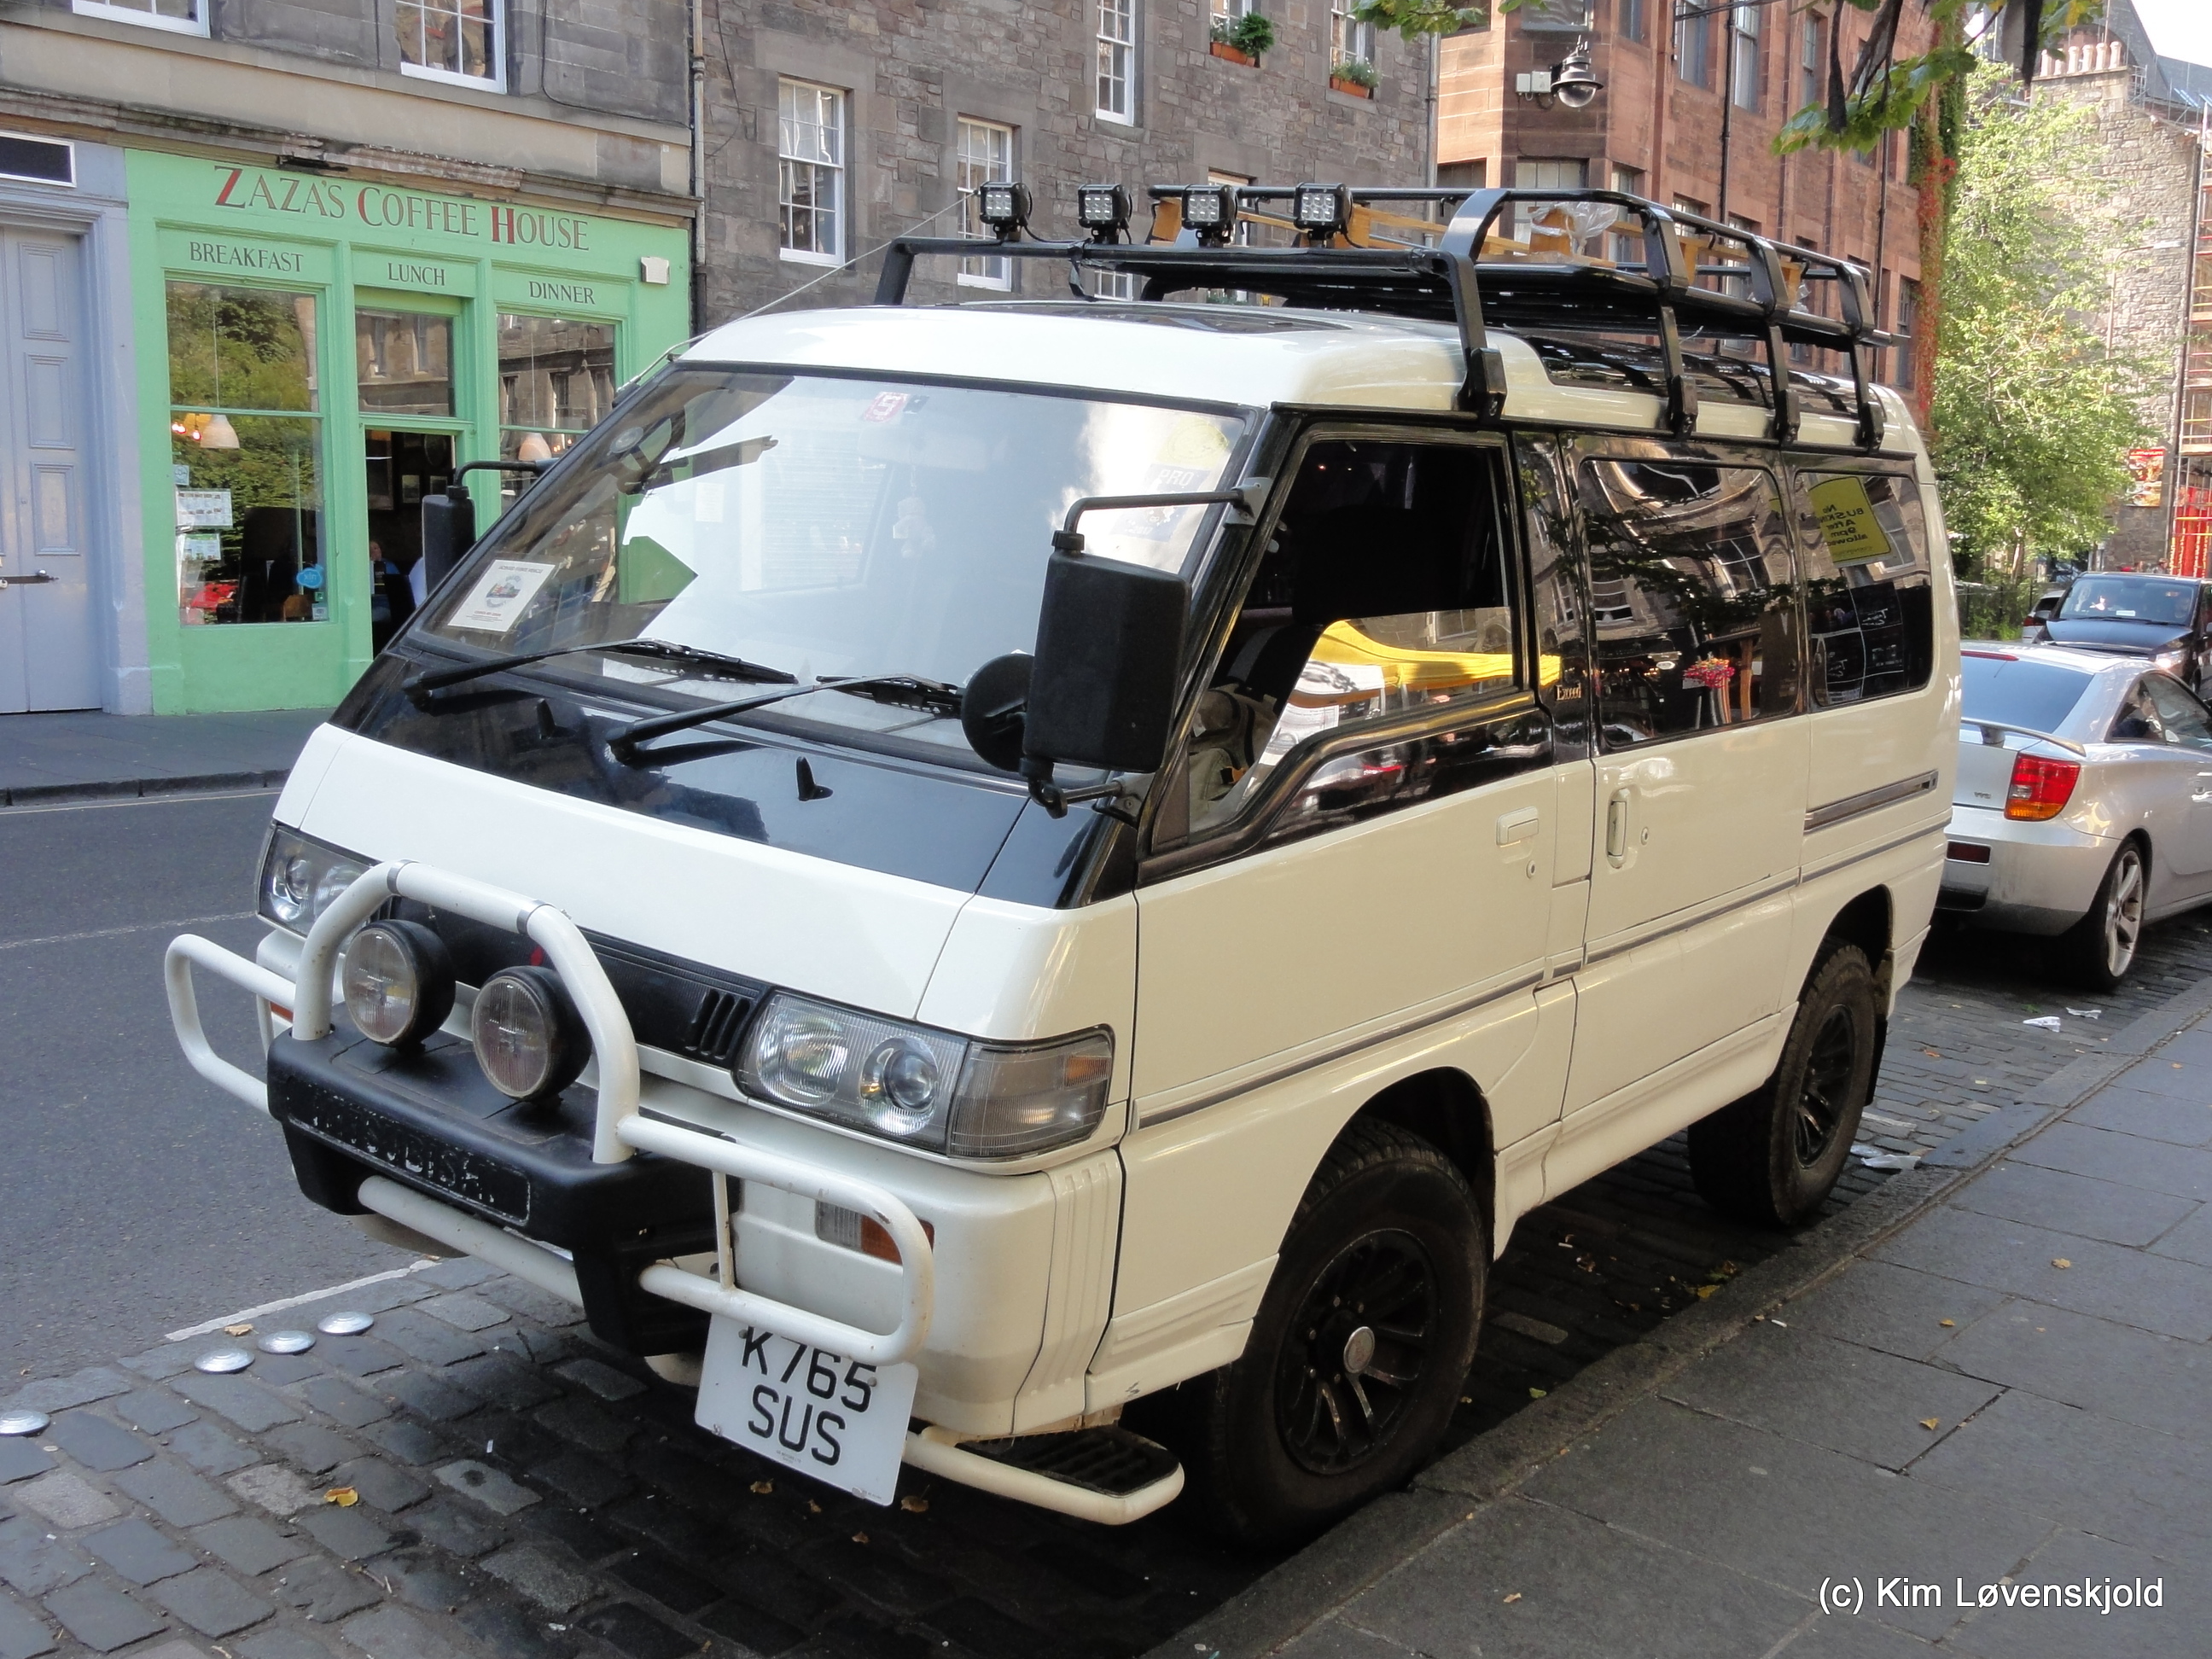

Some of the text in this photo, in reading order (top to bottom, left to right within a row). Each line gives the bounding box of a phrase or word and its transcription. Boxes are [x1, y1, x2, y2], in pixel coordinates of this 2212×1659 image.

[214, 166, 590, 251] ZAZA'S COFFEE HOUSE
[189, 241, 303, 272] BREAKFAST
[387, 262, 445, 287] LUNCH
[528, 280, 596, 305] DINNER
[742, 1325, 877, 1413] K765
[748, 1384, 846, 1466] SUS
